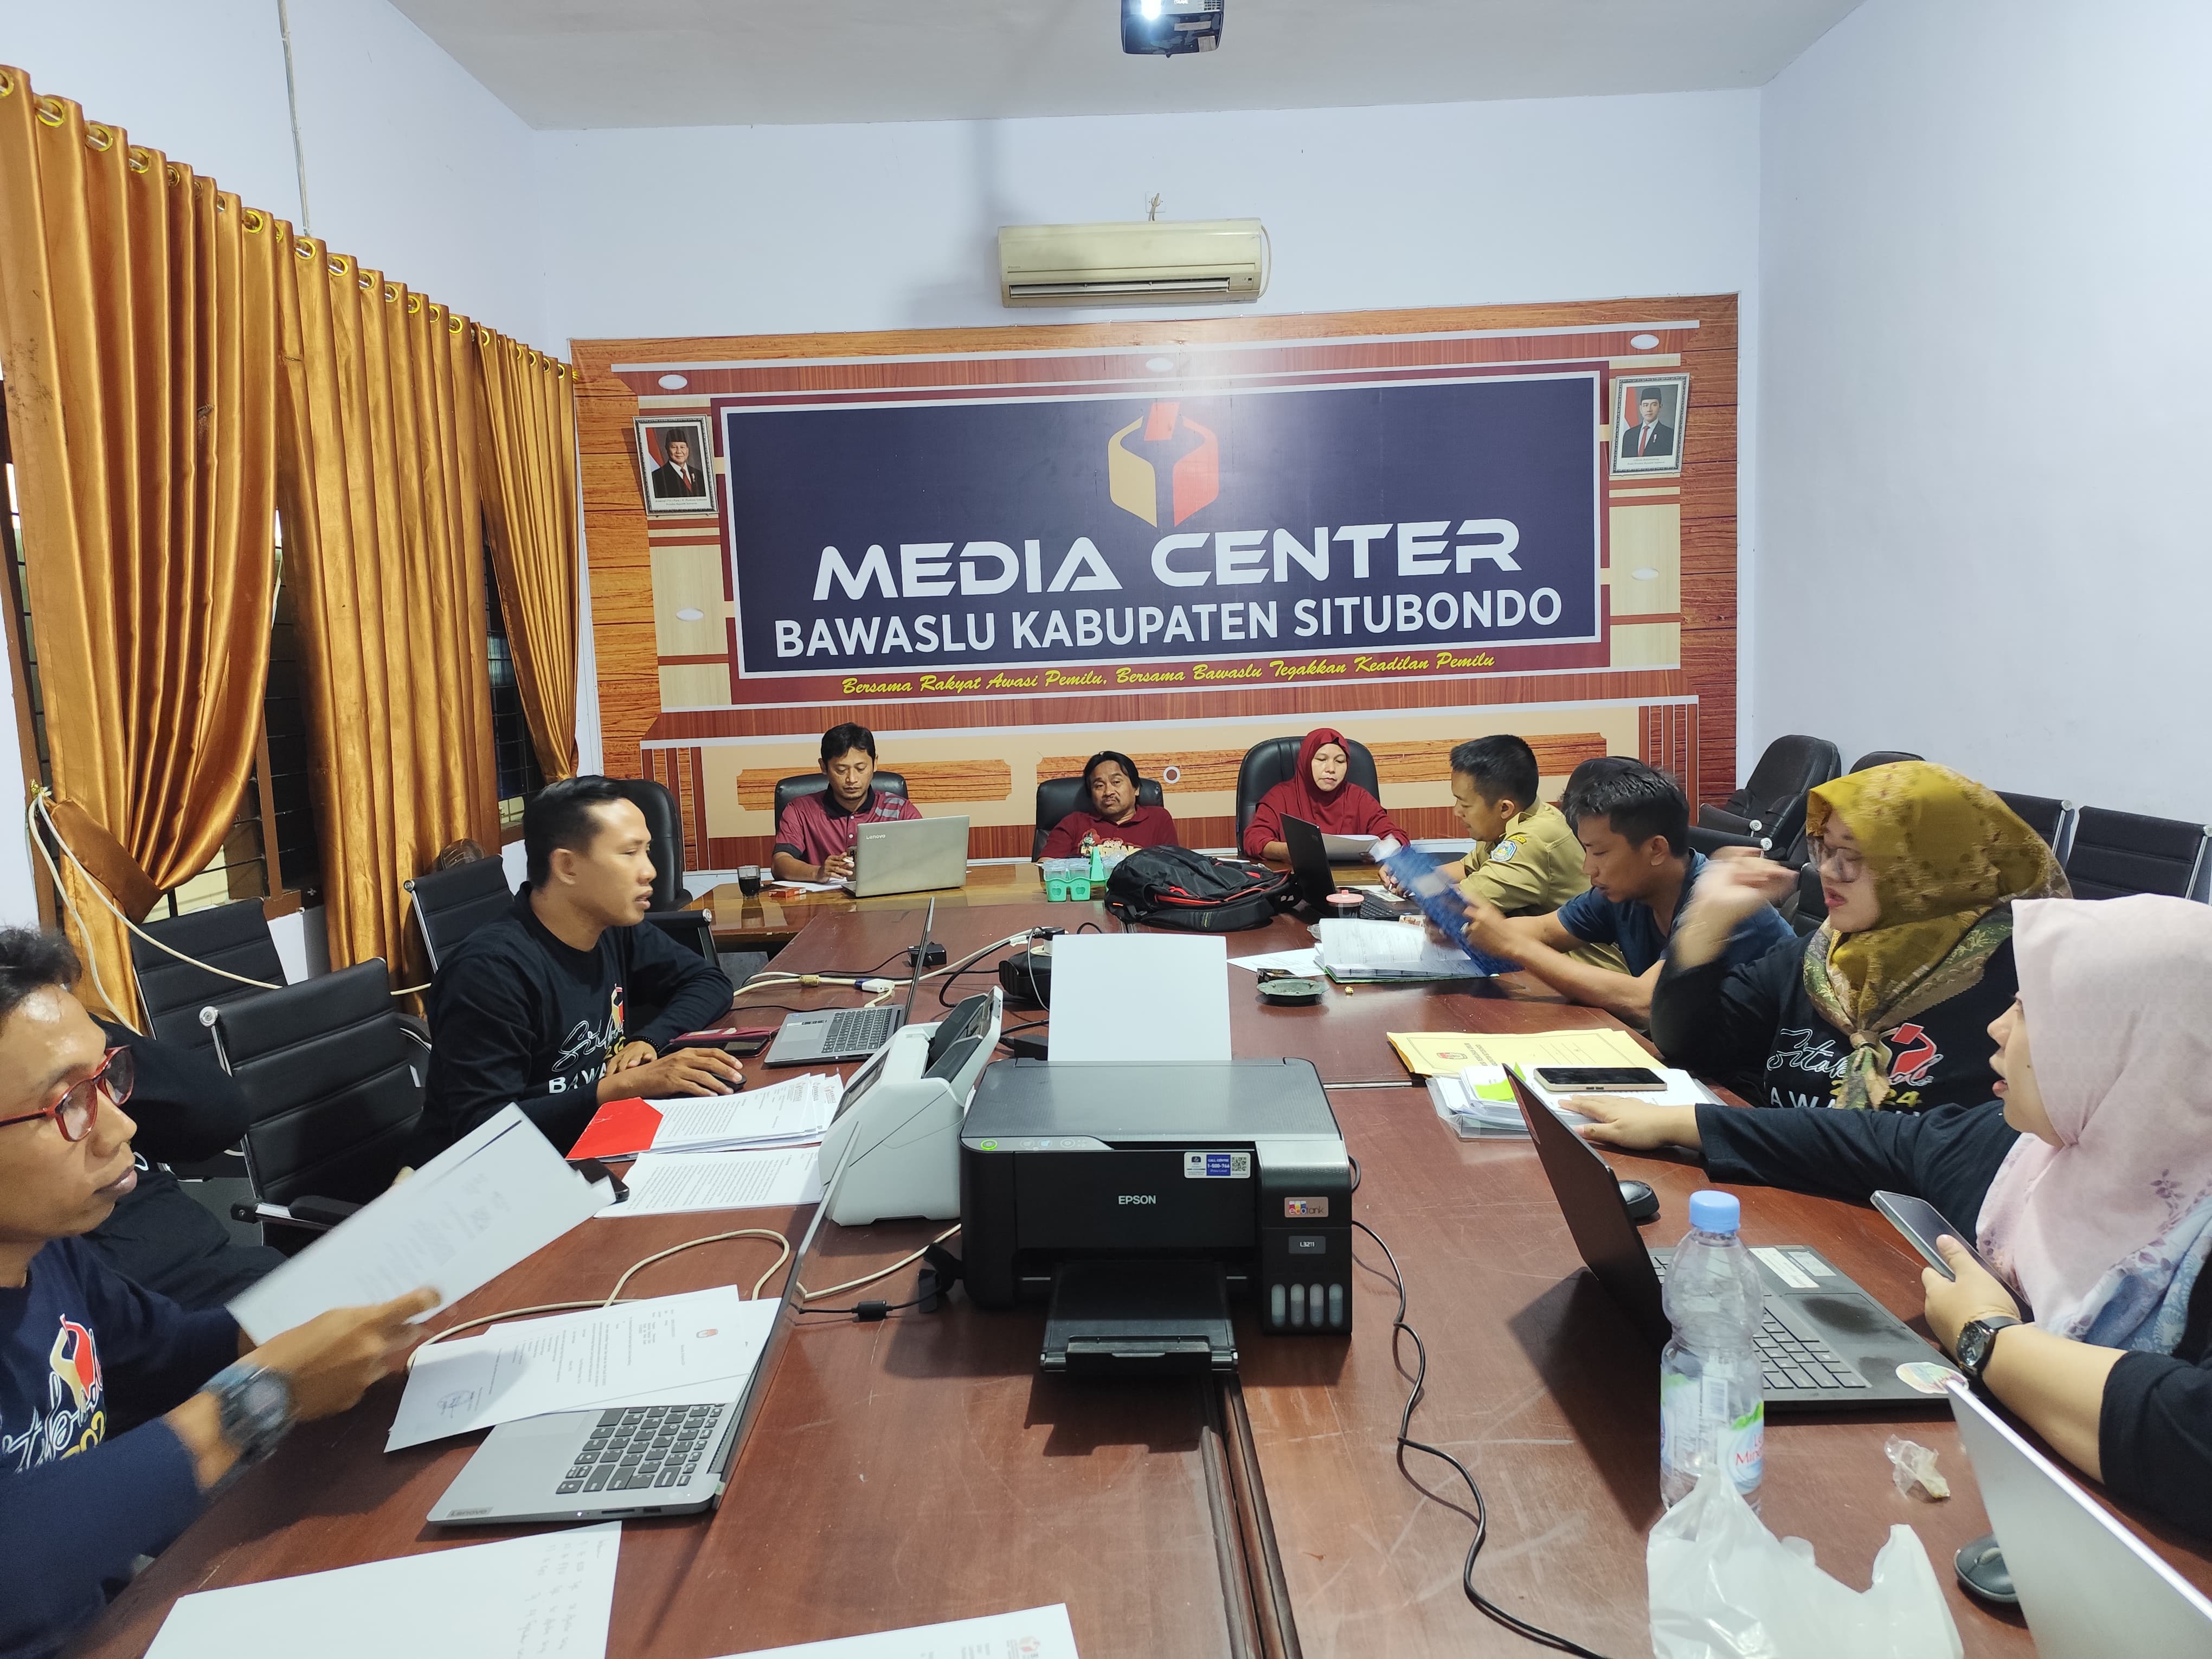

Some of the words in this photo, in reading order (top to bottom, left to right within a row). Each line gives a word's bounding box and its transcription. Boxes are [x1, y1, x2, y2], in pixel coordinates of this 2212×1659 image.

[813, 537, 1123, 601] MEDIA
[1151, 518, 1522, 588] CENTER
[775, 613, 995, 658] BAWASLU
[1012, 603, 1277, 650] KABUPATEN
[1294, 587, 1562, 637] SITUBONDO
[841, 676, 914, 695] Bersama
[919, 673, 982, 695] Rakyat
[985, 671, 1039, 690] Awasi
[1044, 668, 1108, 688] Pemilu,
[1116, 666, 1186, 685] Bersama
[1193, 663, 1263, 681] Bawaslu
[1269, 658, 1348, 682] Tegakkan
[1353, 654, 1430, 673] Keadilan
[1435, 651, 1495, 670] Pemilu
[1118, 1195, 1156, 1205] EPSON
